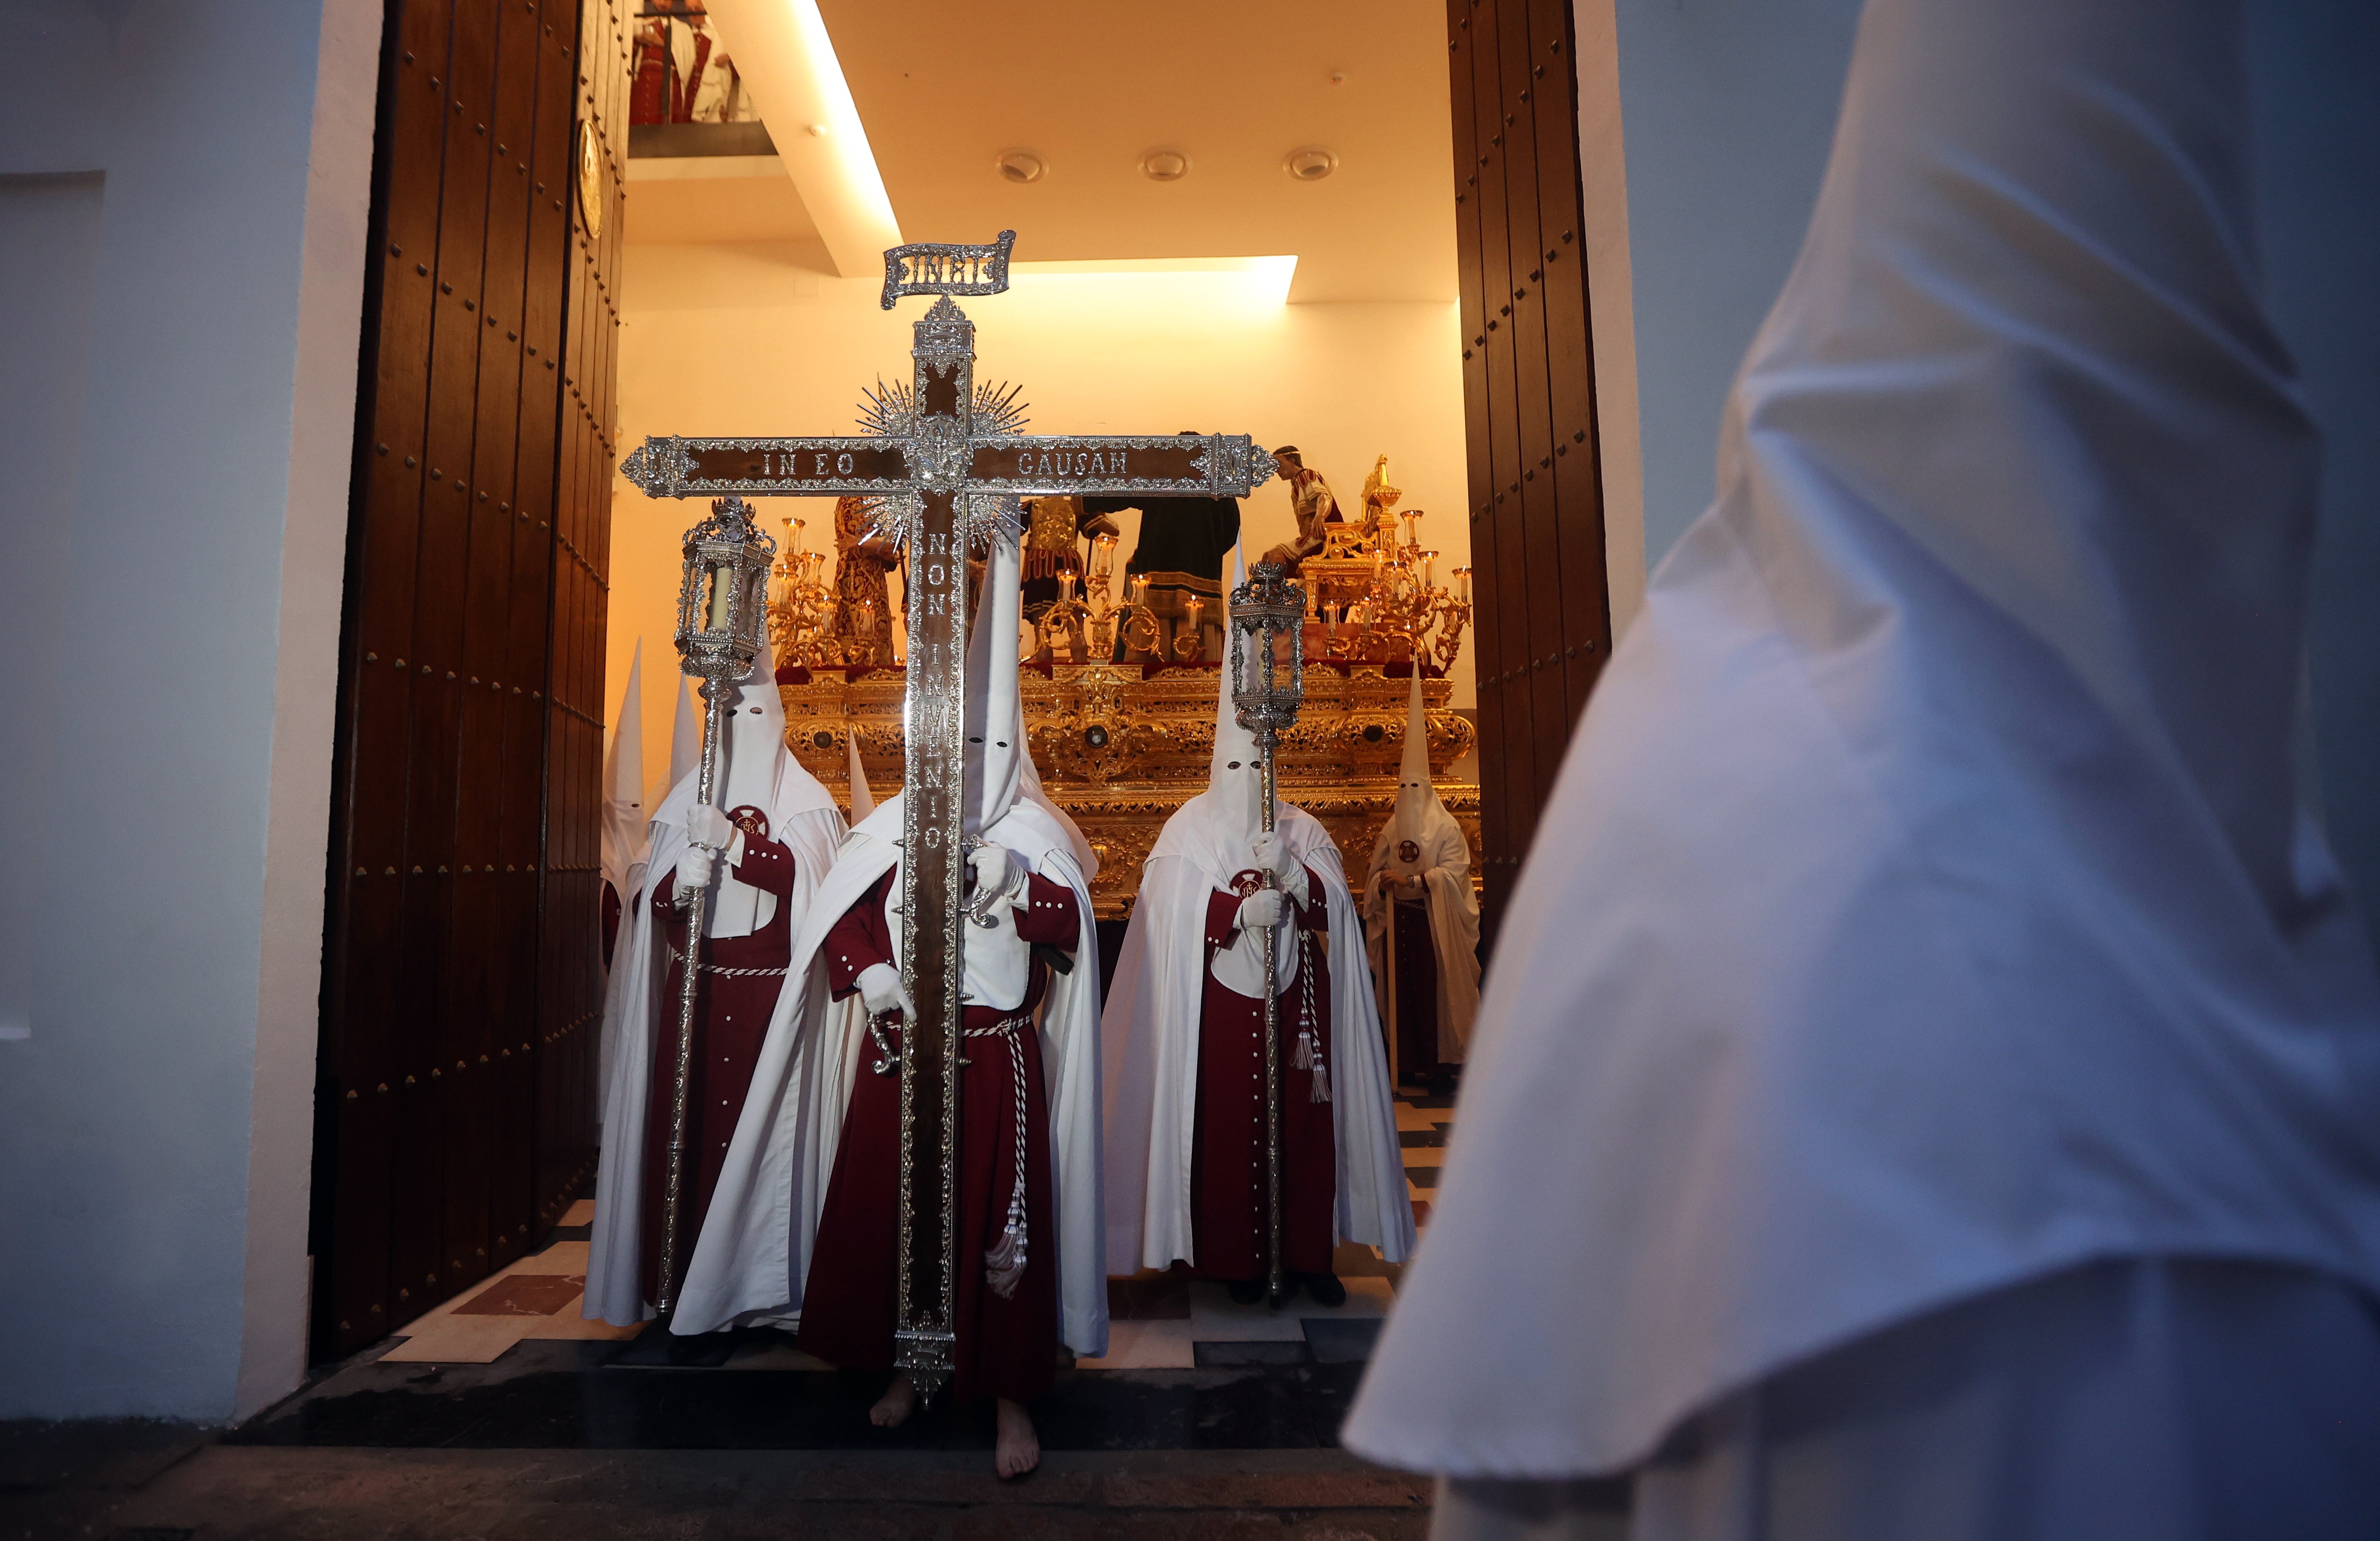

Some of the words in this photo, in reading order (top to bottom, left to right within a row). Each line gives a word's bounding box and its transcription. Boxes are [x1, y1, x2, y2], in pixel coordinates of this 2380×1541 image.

[911, 254, 978, 284] INRI
[763, 454, 796, 475] IN
[815, 454, 854, 474] EO
[927, 534, 946, 615] NON
[924, 644, 944, 849] INVENIO
